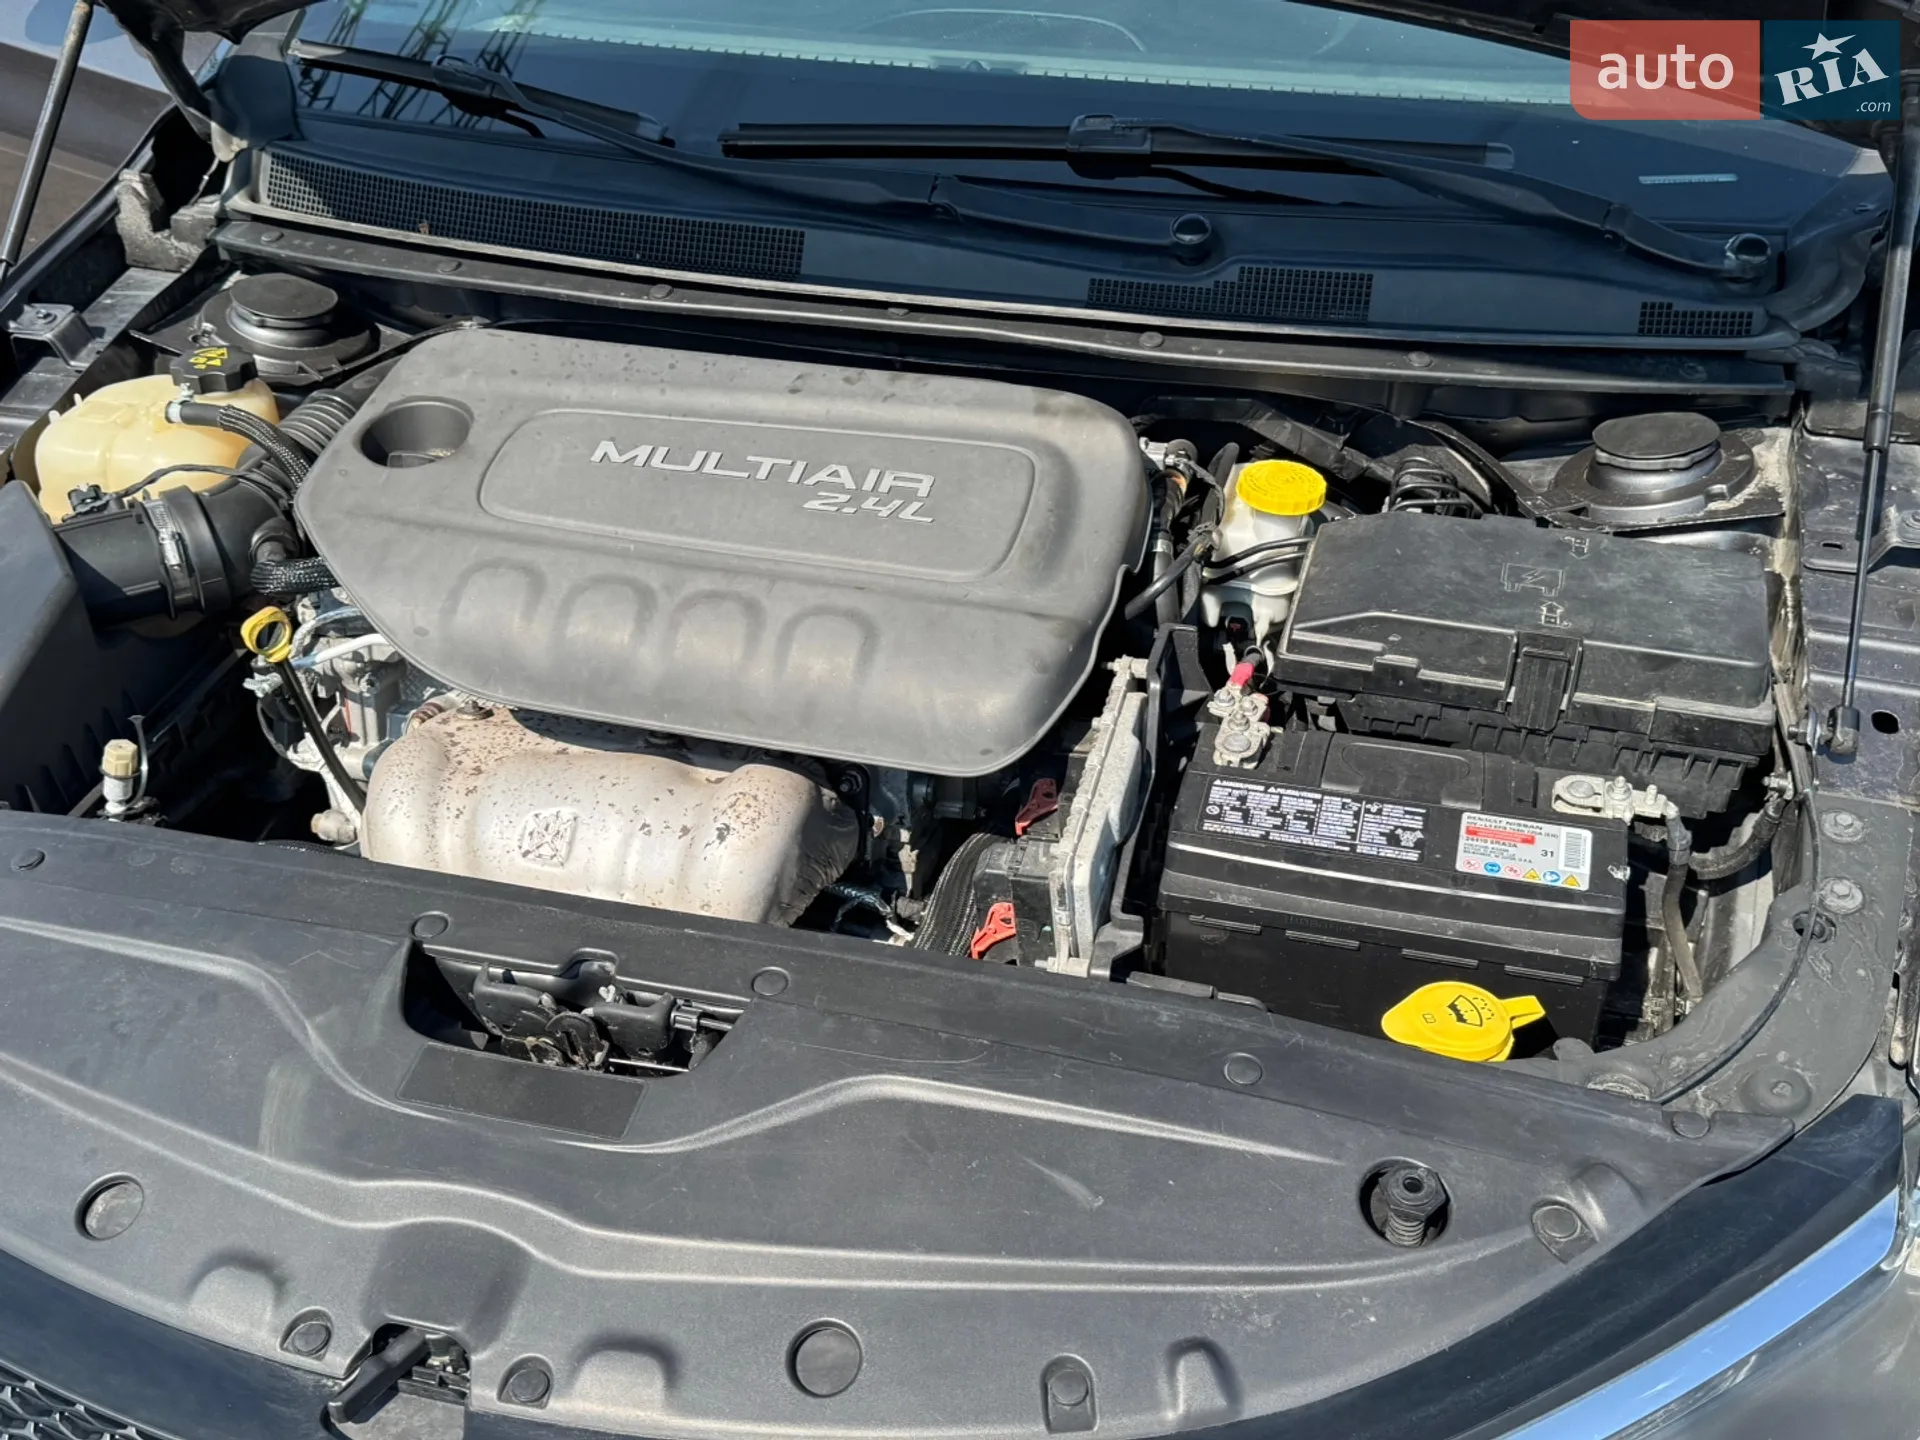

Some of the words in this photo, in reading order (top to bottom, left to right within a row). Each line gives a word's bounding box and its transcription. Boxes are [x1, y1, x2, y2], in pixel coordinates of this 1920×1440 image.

[590, 440, 936, 499] MULTIAIR
[802, 491, 935, 523] 2.4L
[1506, 820, 1543, 830] NISSAN
[1540, 849, 1555, 858] 31
